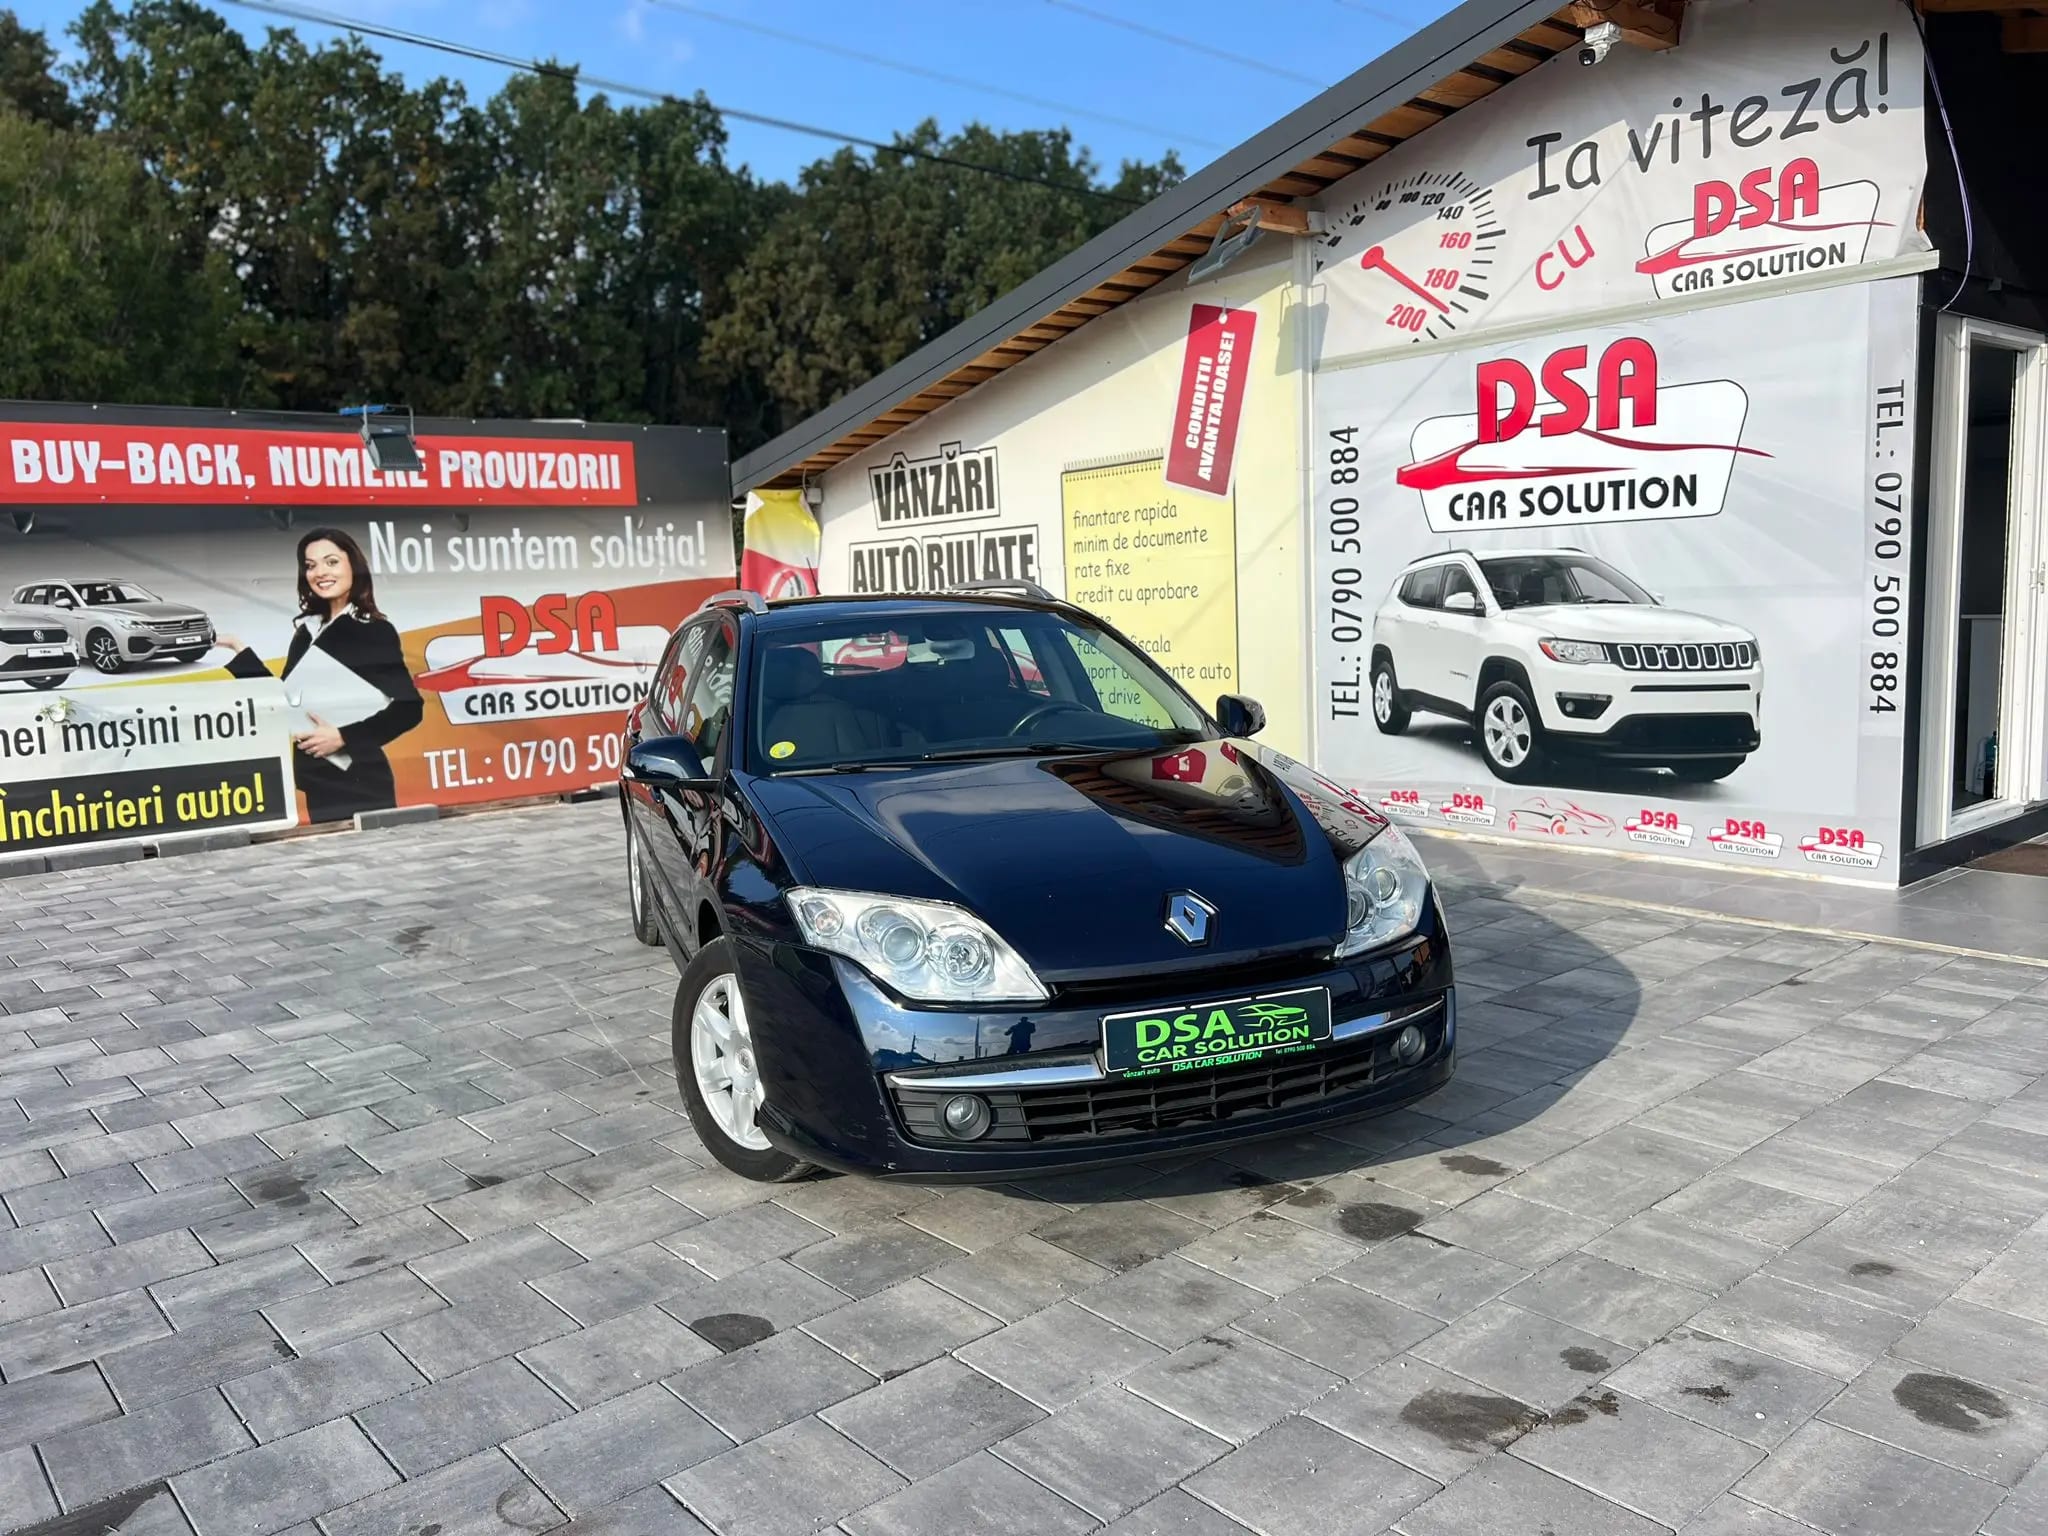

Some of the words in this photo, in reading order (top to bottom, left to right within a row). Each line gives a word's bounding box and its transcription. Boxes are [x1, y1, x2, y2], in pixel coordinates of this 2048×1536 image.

[1628, 32, 1889, 173] viteză!
[1399, 191, 1420, 204] 100
[1421, 192, 1445, 206] 120
[1436, 205, 1464, 220] 140
[1693, 157, 1820, 239] DSA
[1439, 232, 1472, 249] 160
[1535, 224, 1595, 291] cu
[1423, 268, 1459, 290] 180
[1671, 267, 1714, 294] CAR
[1722, 241, 1845, 286] SOLUTION
[1385, 303, 1427, 332] 200
[1198, 331, 1235, 481] AVANTAJOASE!
[1476, 337, 1658, 444] DSA
[11, 439, 256, 489] BUY-BACK,
[439, 450, 622, 491] PROVIZORII
[1329, 425, 1360, 485] 884
[873, 450, 996, 522] VÂNZĂRI
[1449, 490, 1507, 523] CAR
[1520, 474, 1697, 517] SOLUTION
[1073, 509, 1130, 530] finantare
[1134, 499, 1178, 526] rapida
[1330, 497, 1362, 554] 500
[1874, 472, 1902, 559] 0790
[368, 521, 435, 574] Noi
[447, 527, 579, 572] suntem
[590, 515, 708, 577] soluția!
[1073, 534, 1109, 554] minim
[1113, 533, 1128, 551] de
[1132, 526, 1208, 549] documente
[853, 544, 920, 592] AUTO
[1075, 562, 1101, 579] rate
[1105, 558, 1131, 577] fixe
[1076, 585, 1114, 604] credit
[1118, 588, 1132, 602] cu
[1136, 581, 1199, 606] aprobare
[1331, 567, 1363, 643] 0790
[1871, 574, 1900, 637] 500
[480, 590, 620, 658] DSA
[1199, 663, 1232, 680] auto
[1330, 655, 1362, 720] TEL.:
[1869, 651, 1898, 714] 884
[464, 692, 516, 716] CAR
[525, 680, 648, 711] SOLUTION
[1108, 686, 1141, 705] drive
[62, 705, 181, 758] mașini
[194, 697, 257, 742] noi!
[423, 748, 494, 790] TEL.:
[502, 736, 577, 781] 0790
[587, 732, 625, 772] 50
[176, 773, 265, 821] auto!
[1390, 790, 1419, 804] DSA
[1453, 793, 1484, 810] DSA
[1640, 809, 1679, 830] DSA
[1725, 818, 1766, 840] DSA
[1818, 827, 1865, 849] DSA
[1649, 834, 1686, 846] SOLUTION
[1735, 845, 1774, 857] SOLUTION
[1811, 852, 1828, 862] CAR
[1829, 854, 1873, 867] SOLUTION
[1135, 1009, 1236, 1049] DSA
[1137, 1044, 1188, 1063] CAR
[1194, 1024, 1310, 1055] SOLUTION
[1172, 1061, 1193, 1072] DSA
[1194, 1057, 1215, 1069] CAR
[1215, 1050, 1263, 1066] SOLUTION
